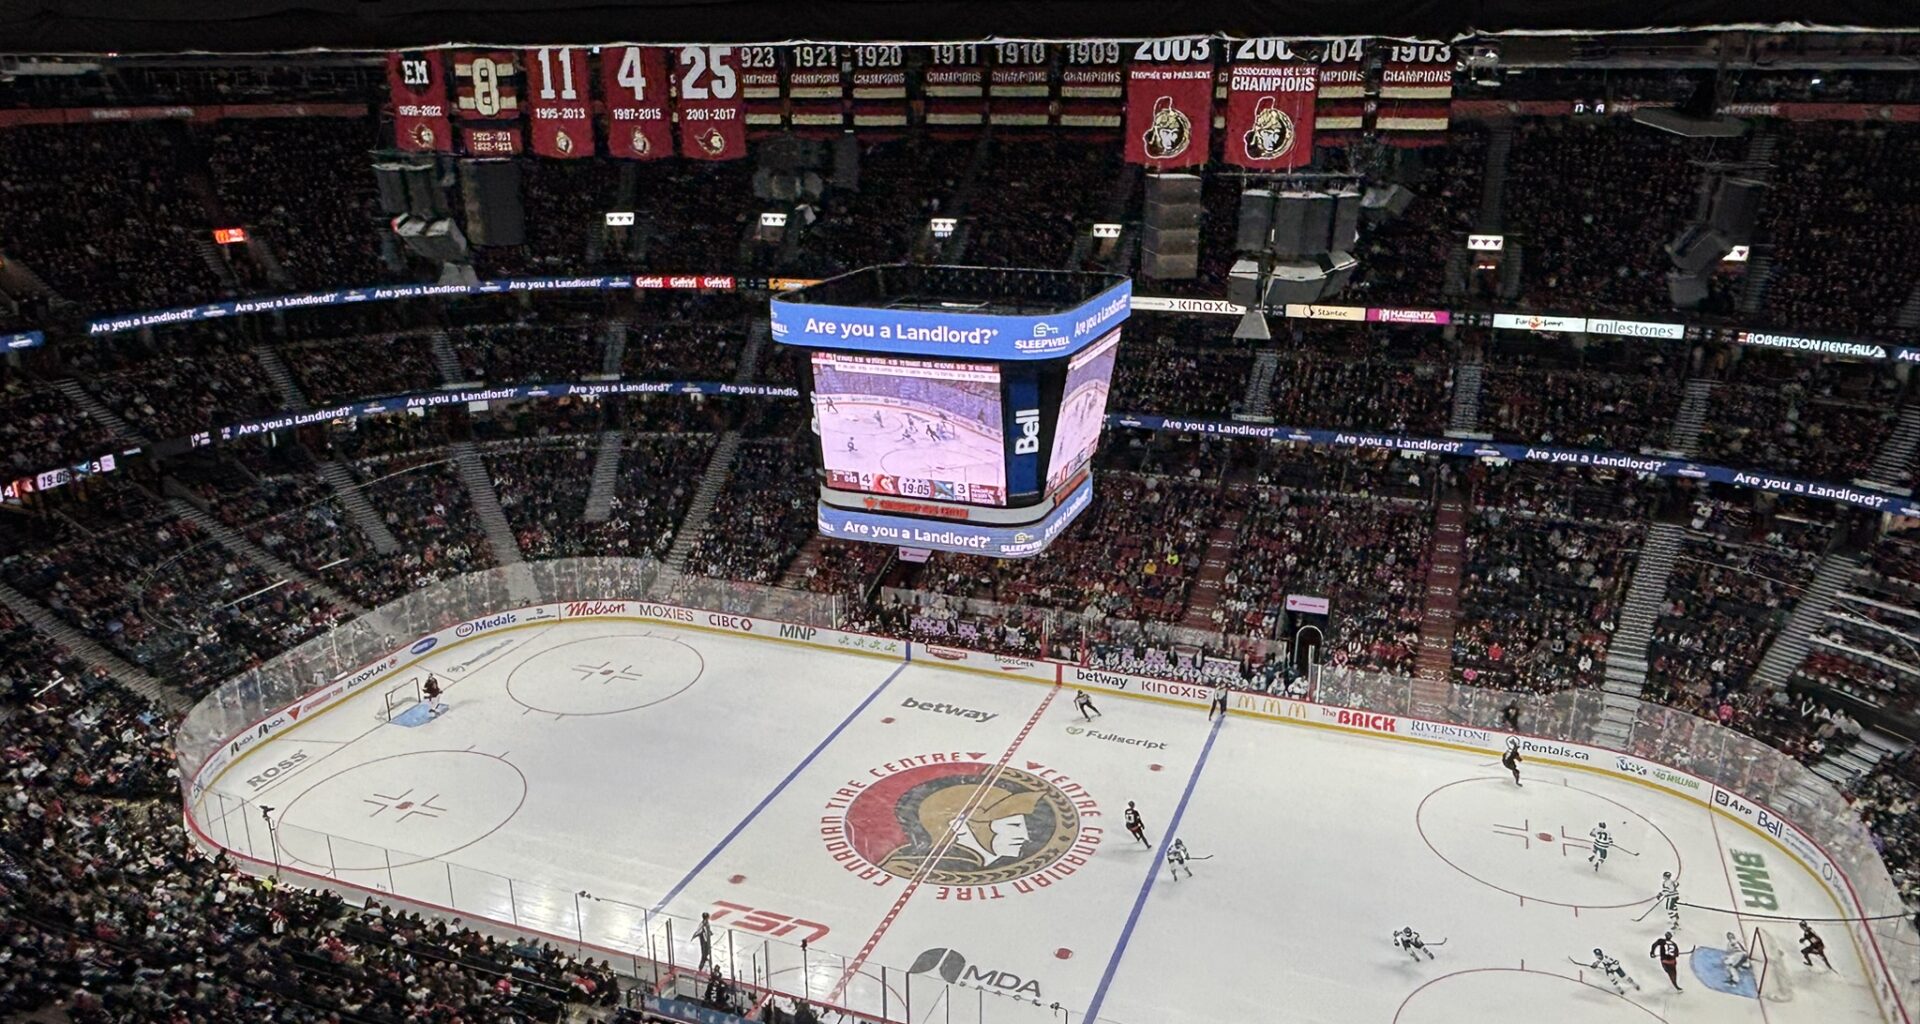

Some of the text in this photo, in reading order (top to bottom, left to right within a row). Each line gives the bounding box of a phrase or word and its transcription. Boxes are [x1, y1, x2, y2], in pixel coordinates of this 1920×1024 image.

[793, 46, 837, 68] 1921
[854, 45, 902, 67] 1920
[930, 44, 978, 66] 1911
[995, 44, 1045, 65] 1910
[1067, 43, 1119, 66] 1909
[402, 60, 427, 85] EM
[537, 48, 577, 101] 11
[617, 47, 647, 101] 4
[681, 47, 737, 101] 25
[1383, 68, 1452, 82] CHAMPIONS
[472, 58, 500, 116] 8
[1231, 76, 1316, 92] CHAMPIONS
[686, 108, 736, 120] 2001-2017
[375, 289, 393, 299] Are
[394, 288, 412, 298] you
[509, 280, 527, 290] Are
[528, 280, 546, 291] you
[235, 300, 254, 312] Are
[255, 300, 275, 313] you
[275, 300, 284, 308] a
[91, 319, 110, 334] Are
[113, 318, 131, 333] you
[133, 319, 141, 327] a
[805, 318, 836, 335] Are
[840, 320, 875, 340] you
[879, 325, 890, 338] a
[1595, 319, 1674, 338] milestones
[1014, 336, 1071, 350] SLEEPWELL
[1746, 332, 1821, 352] ROBERTSON
[568, 384, 588, 394] Are
[589, 384, 609, 396] you
[611, 385, 618, 393] a
[719, 384, 737, 394] Are
[738, 385, 756, 396] you
[758, 385, 765, 394] a
[407, 395, 425, 408] Are
[426, 395, 449, 408] you
[450, 395, 459, 404] a
[239, 421, 260, 435] Are
[262, 420, 283, 433] you
[285, 418, 293, 428] a
[1015, 409, 1041, 456] Bell
[1162, 418, 1182, 430] Are
[1184, 421, 1206, 432] you
[1207, 424, 1216, 432] a
[1335, 433, 1355, 446] Are
[1357, 436, 1383, 448] you
[1385, 438, 1393, 447] a
[1525, 448, 1550, 460] Are
[1552, 451, 1578, 463] you
[1580, 454, 1590, 463] a
[92, 462, 101, 473] 3
[861, 473, 871, 485] 4
[902, 482, 930, 496] 19:05
[957, 483, 967, 494] 3
[1734, 472, 1760, 486] Are
[1761, 477, 1792, 492] you
[1794, 482, 1804, 492] a
[843, 520, 869, 534] Are
[871, 525, 899, 540] you
[901, 528, 911, 539] a
[565, 601, 626, 618] Molson
[639, 604, 694, 622] MOXIES
[475, 613, 517, 632] Medals
[709, 614, 739, 629] CIBC
[780, 624, 817, 641] MNP
[1077, 669, 1128, 689] betway
[901, 697, 999, 723] betway
[1322, 708, 1396, 732] The BRICK
[1085, 730, 1169, 752] Fullscript
[1411, 720, 1491, 742] RIVERSTONE
[1522, 741, 1590, 761] Rentals.ca
[246, 749, 308, 787] ROSS
[1038, 769, 1102, 818] CENTRE
[821, 752, 962, 888] CANADIAN TIRE CENTRE
[1757, 810, 1783, 838] Bell
[1015, 827, 1104, 896] CANADIAN
[1731, 850, 1780, 911] BMR
[936, 885, 1005, 902] TIRE
[710, 900, 830, 943] TSN
[963, 965, 1041, 999] MDA
